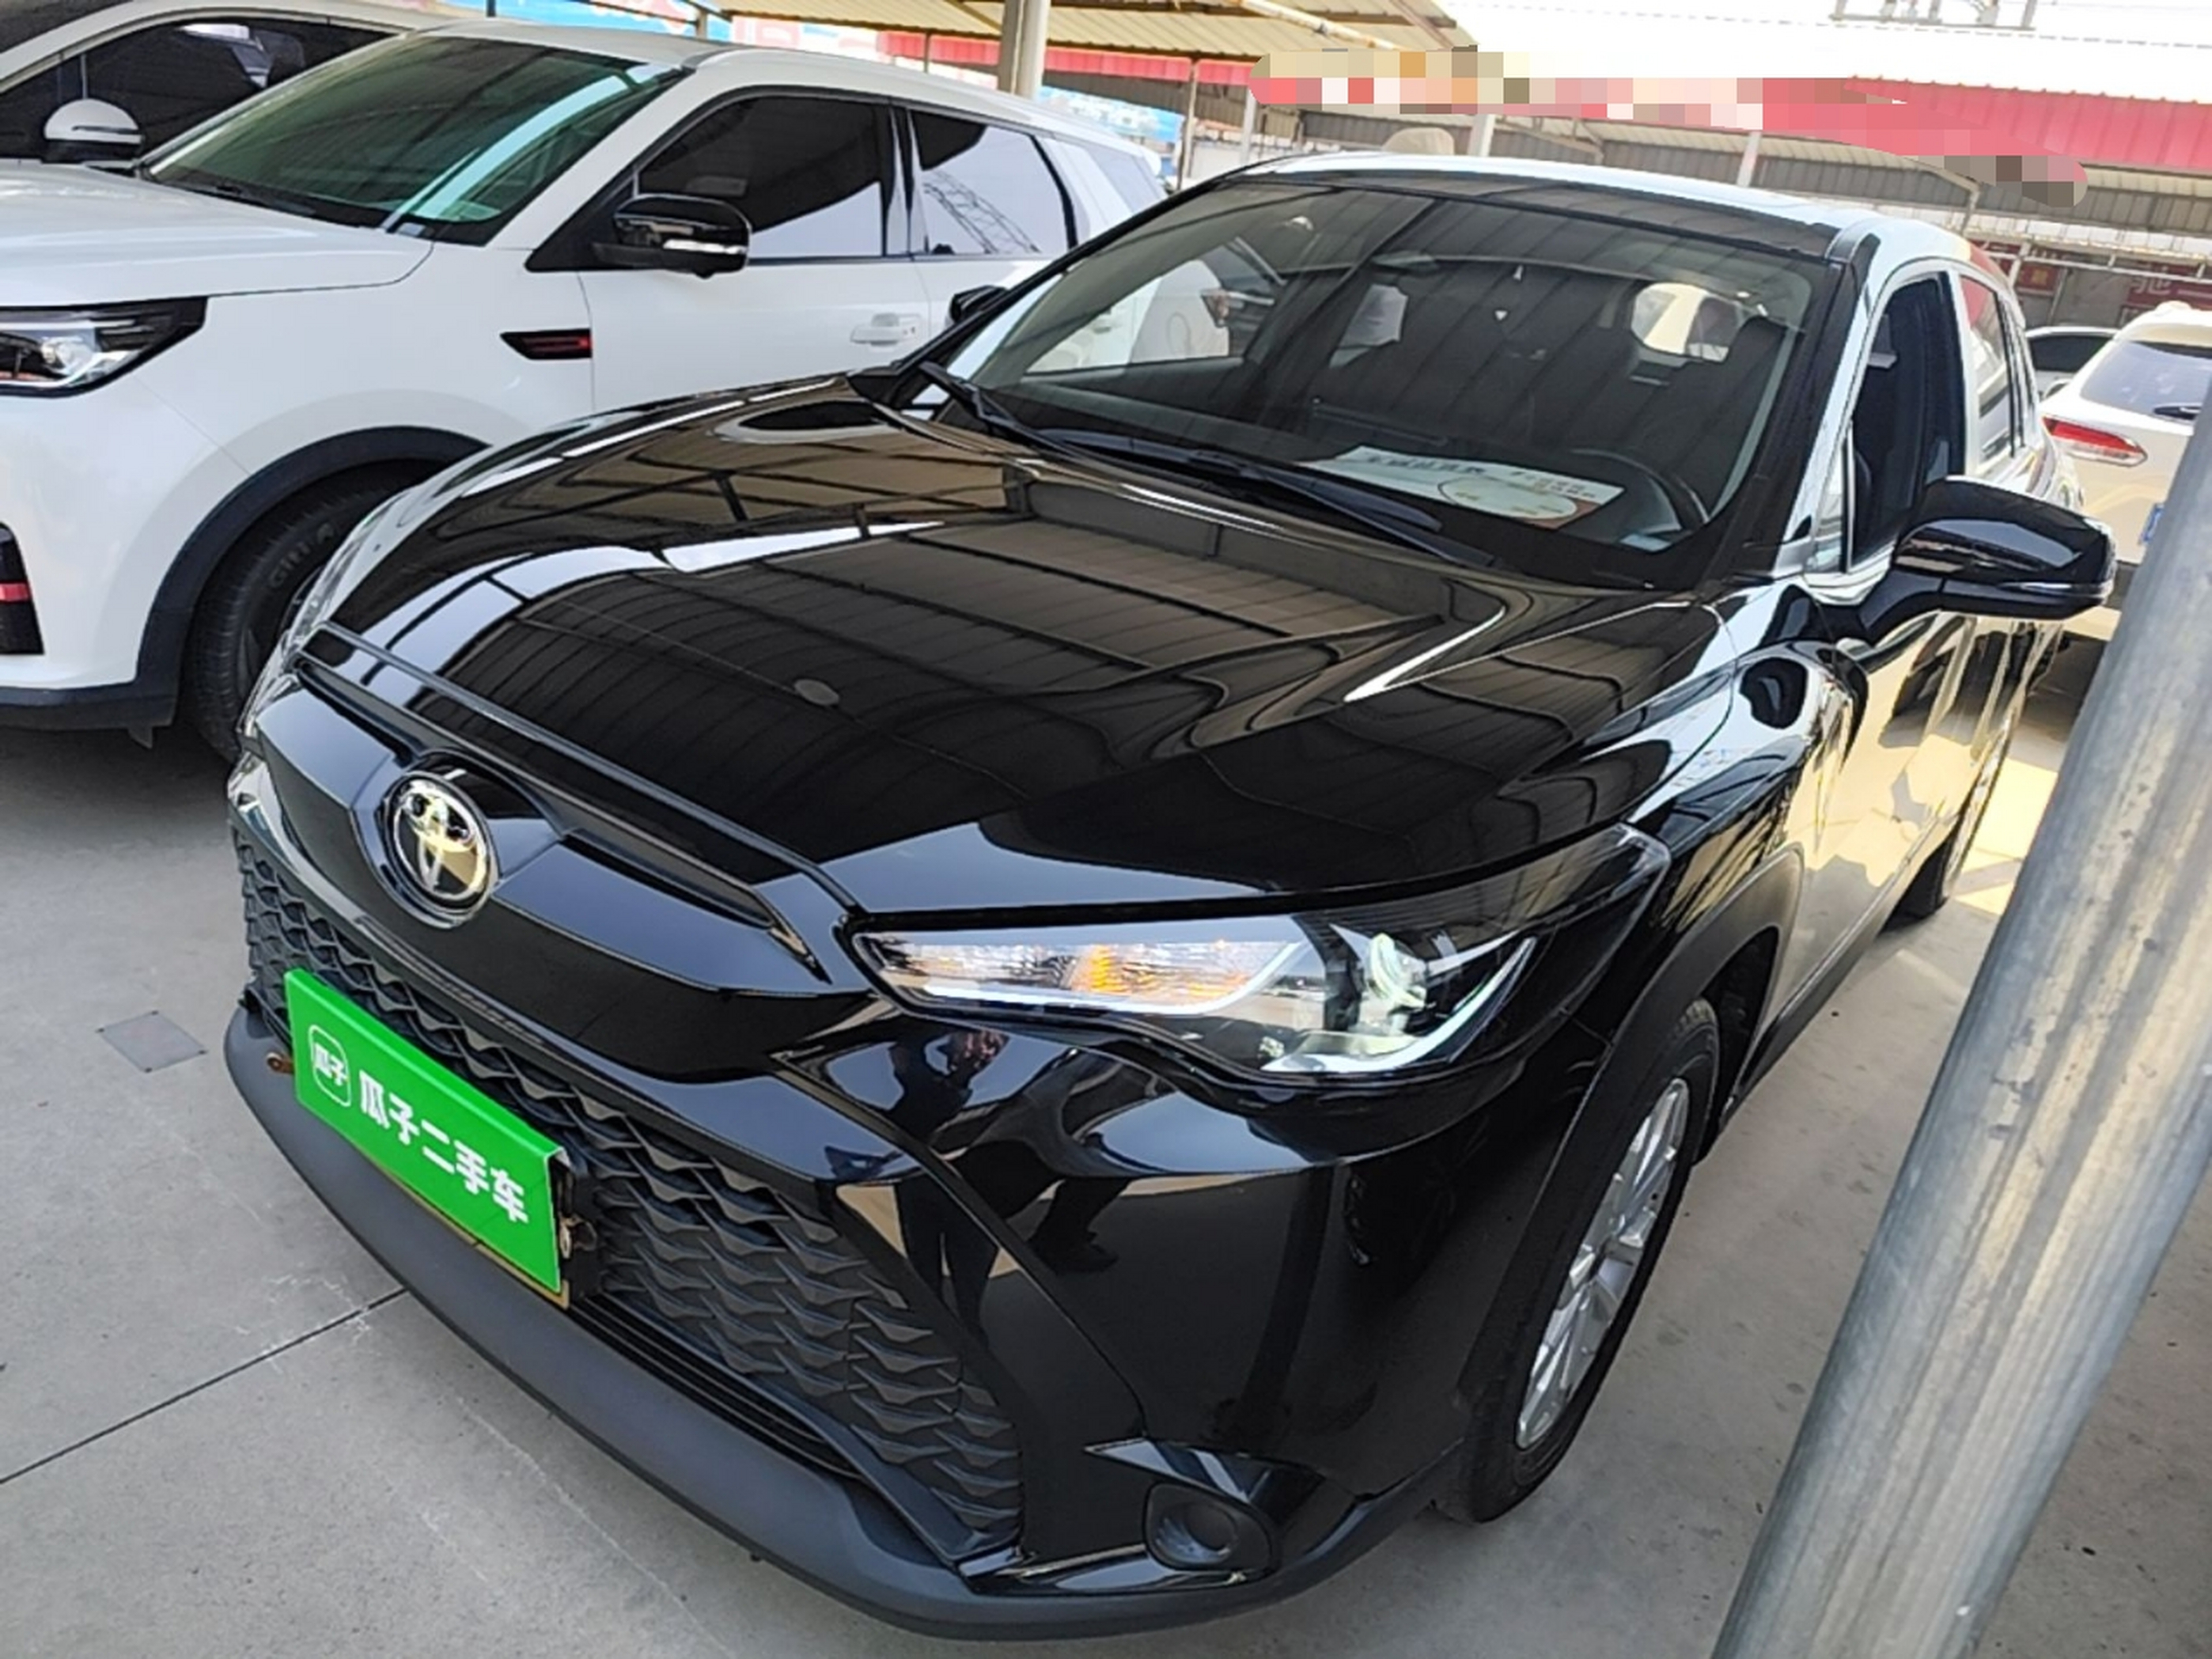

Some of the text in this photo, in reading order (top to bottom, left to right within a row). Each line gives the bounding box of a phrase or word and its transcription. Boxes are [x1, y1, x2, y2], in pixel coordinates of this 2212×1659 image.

[315, 1043, 348, 1086] 瓜子
[359, 1069, 529, 1224] 瓜子二手车
